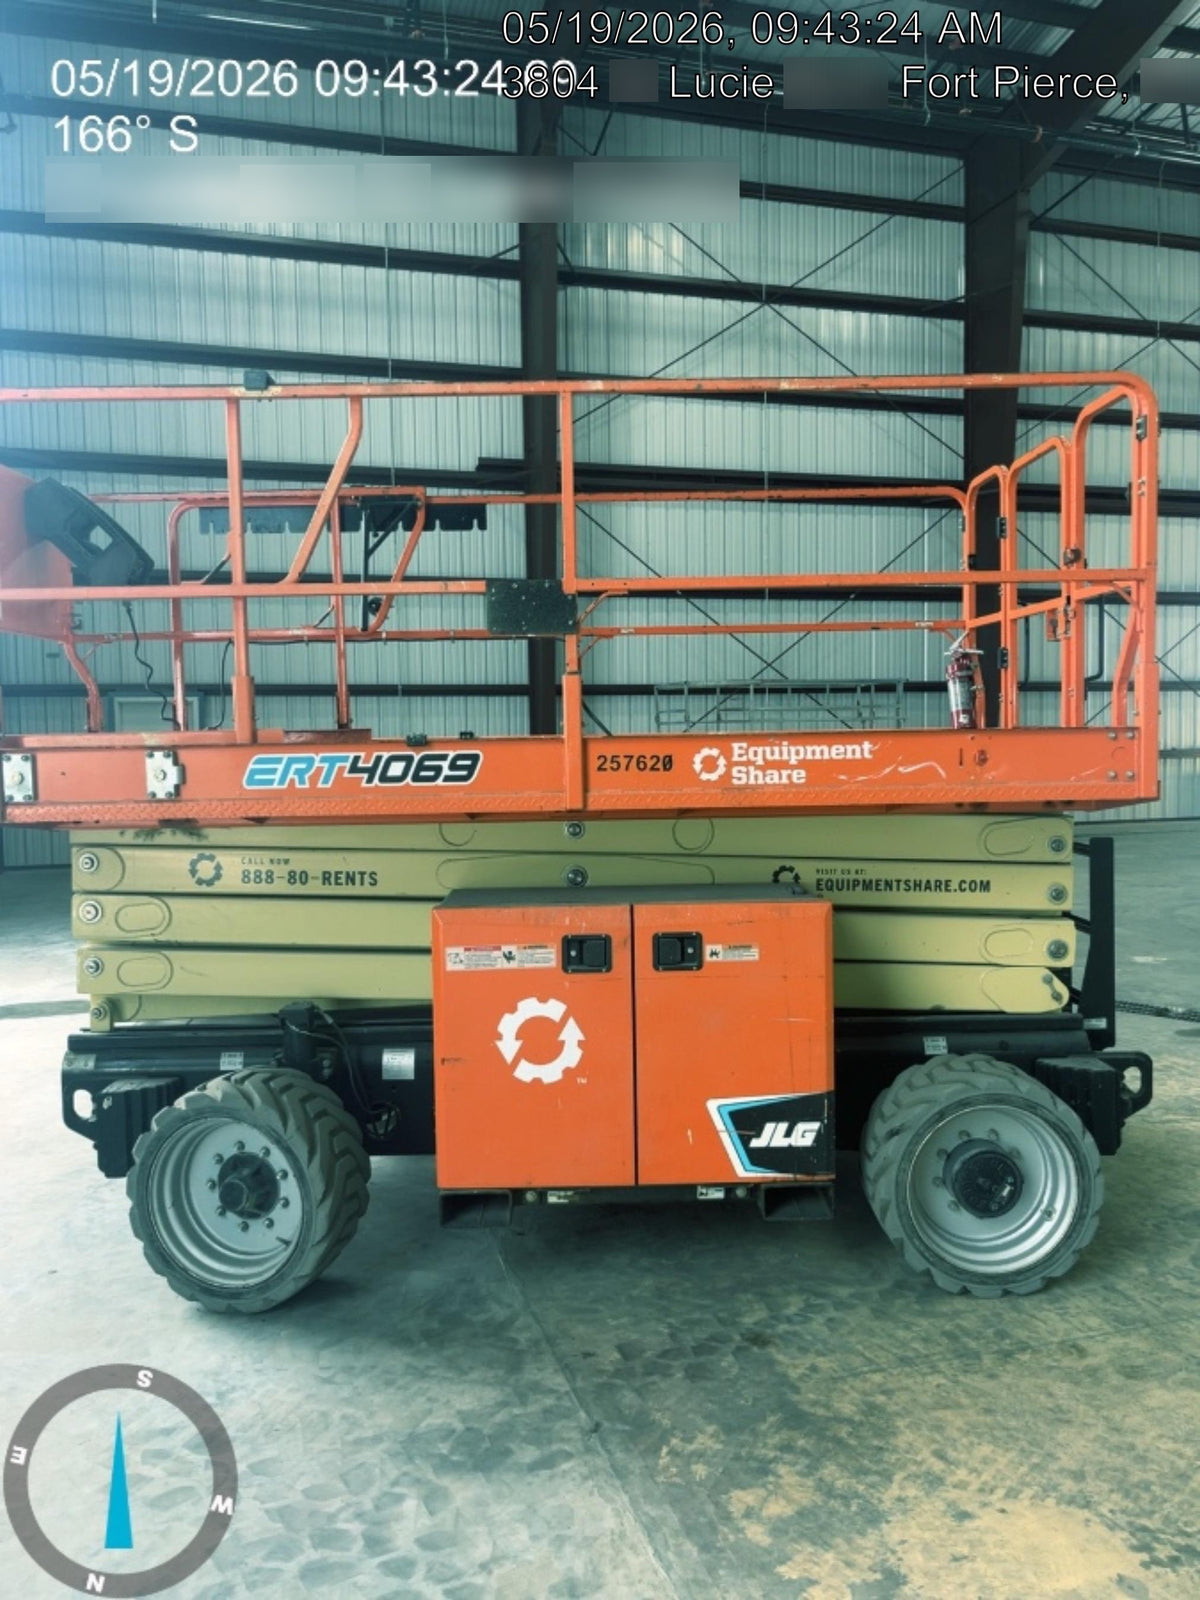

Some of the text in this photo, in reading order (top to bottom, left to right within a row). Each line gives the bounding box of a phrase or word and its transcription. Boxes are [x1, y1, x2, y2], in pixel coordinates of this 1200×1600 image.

[731, 740, 876, 764] Equipment
[243, 752, 481, 789] ERT4069
[596, 754, 674, 772] 257620
[731, 766, 807, 785] Share
[241, 857, 265, 865] CALL
[241, 869, 378, 887] 888-80-RENTS
[815, 878, 991, 893] EQUIPMENTSHARE.COM
[749, 1121, 821, 1147] JLG
